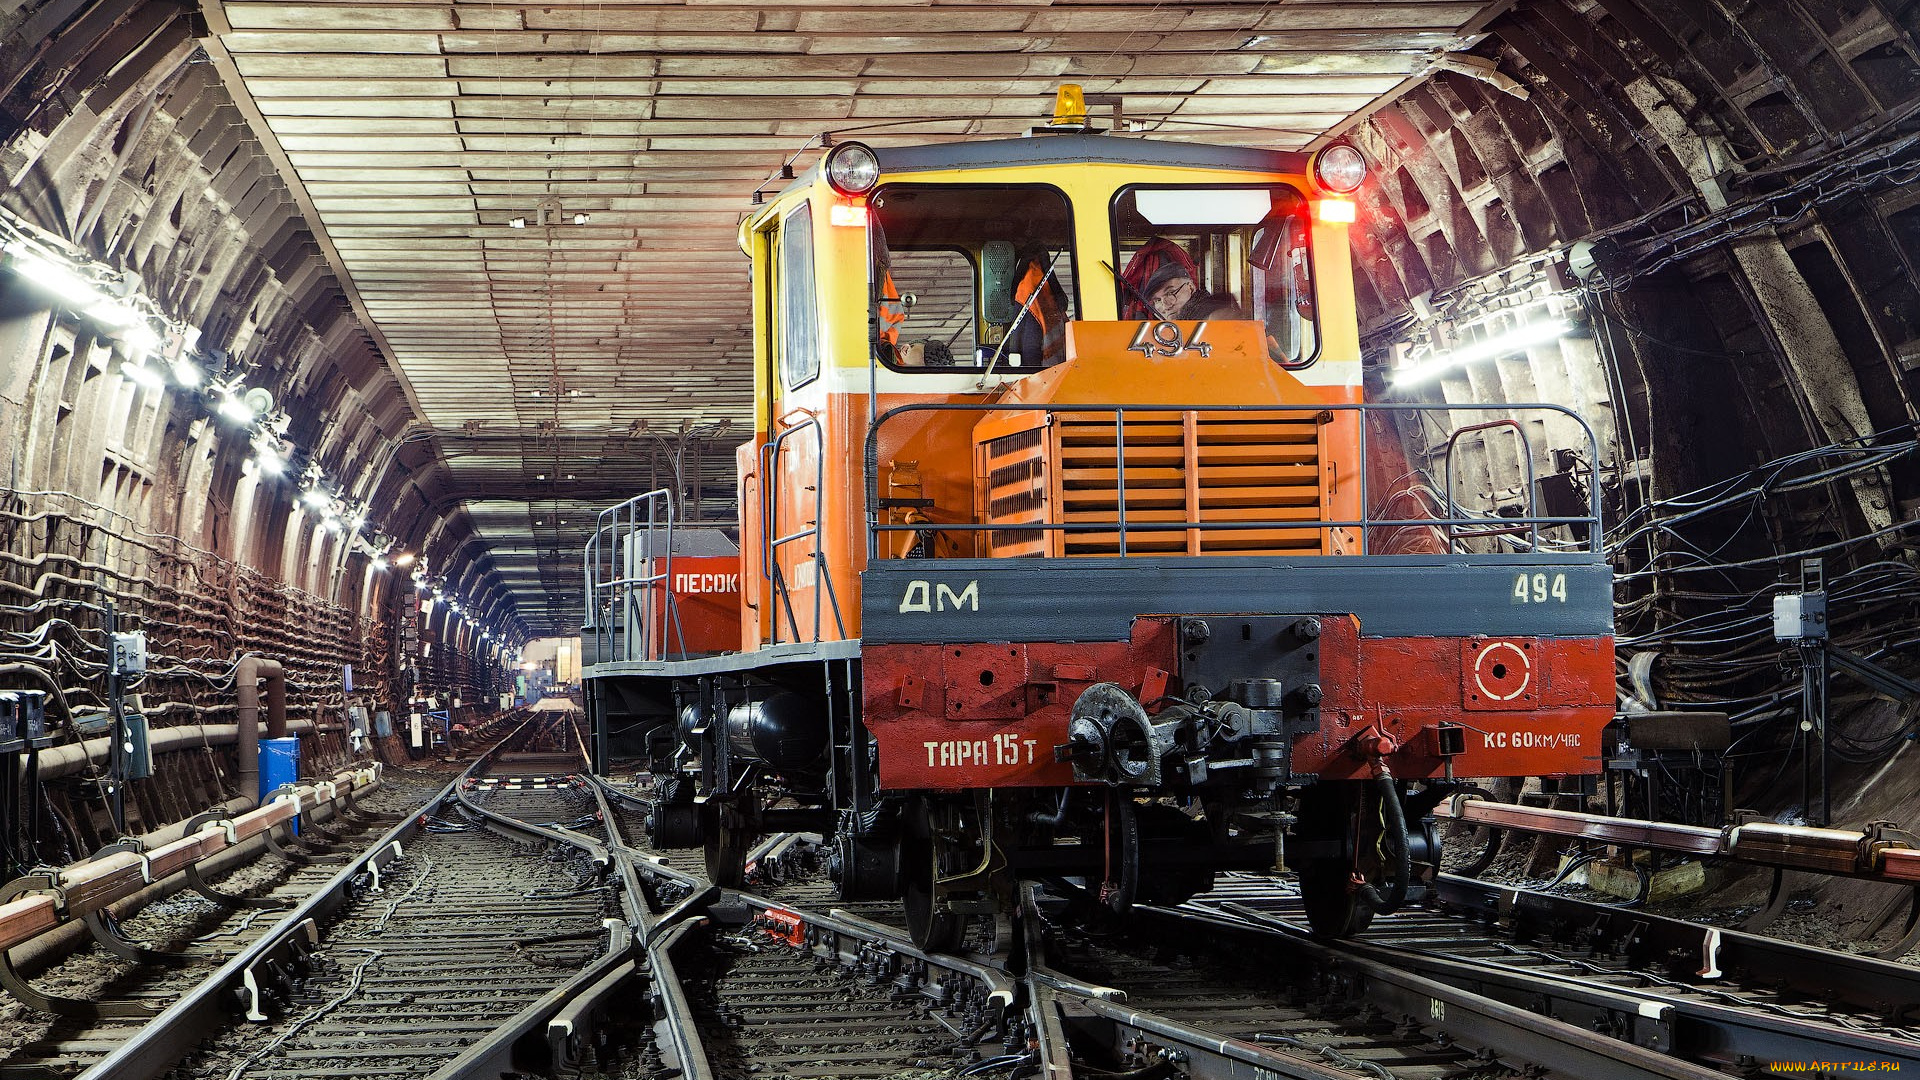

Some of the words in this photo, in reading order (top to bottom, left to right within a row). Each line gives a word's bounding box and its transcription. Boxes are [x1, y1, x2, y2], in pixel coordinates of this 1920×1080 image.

[1127, 321, 1213, 359] 494
[675, 573, 738, 593] ПЕСОК
[899, 579, 979, 614] ДМ
[1514, 572, 1567, 603] 494
[923, 740, 988, 767] ТАРА
[992, 733, 1019, 765] 15
[1484, 731, 1507, 748] КС
